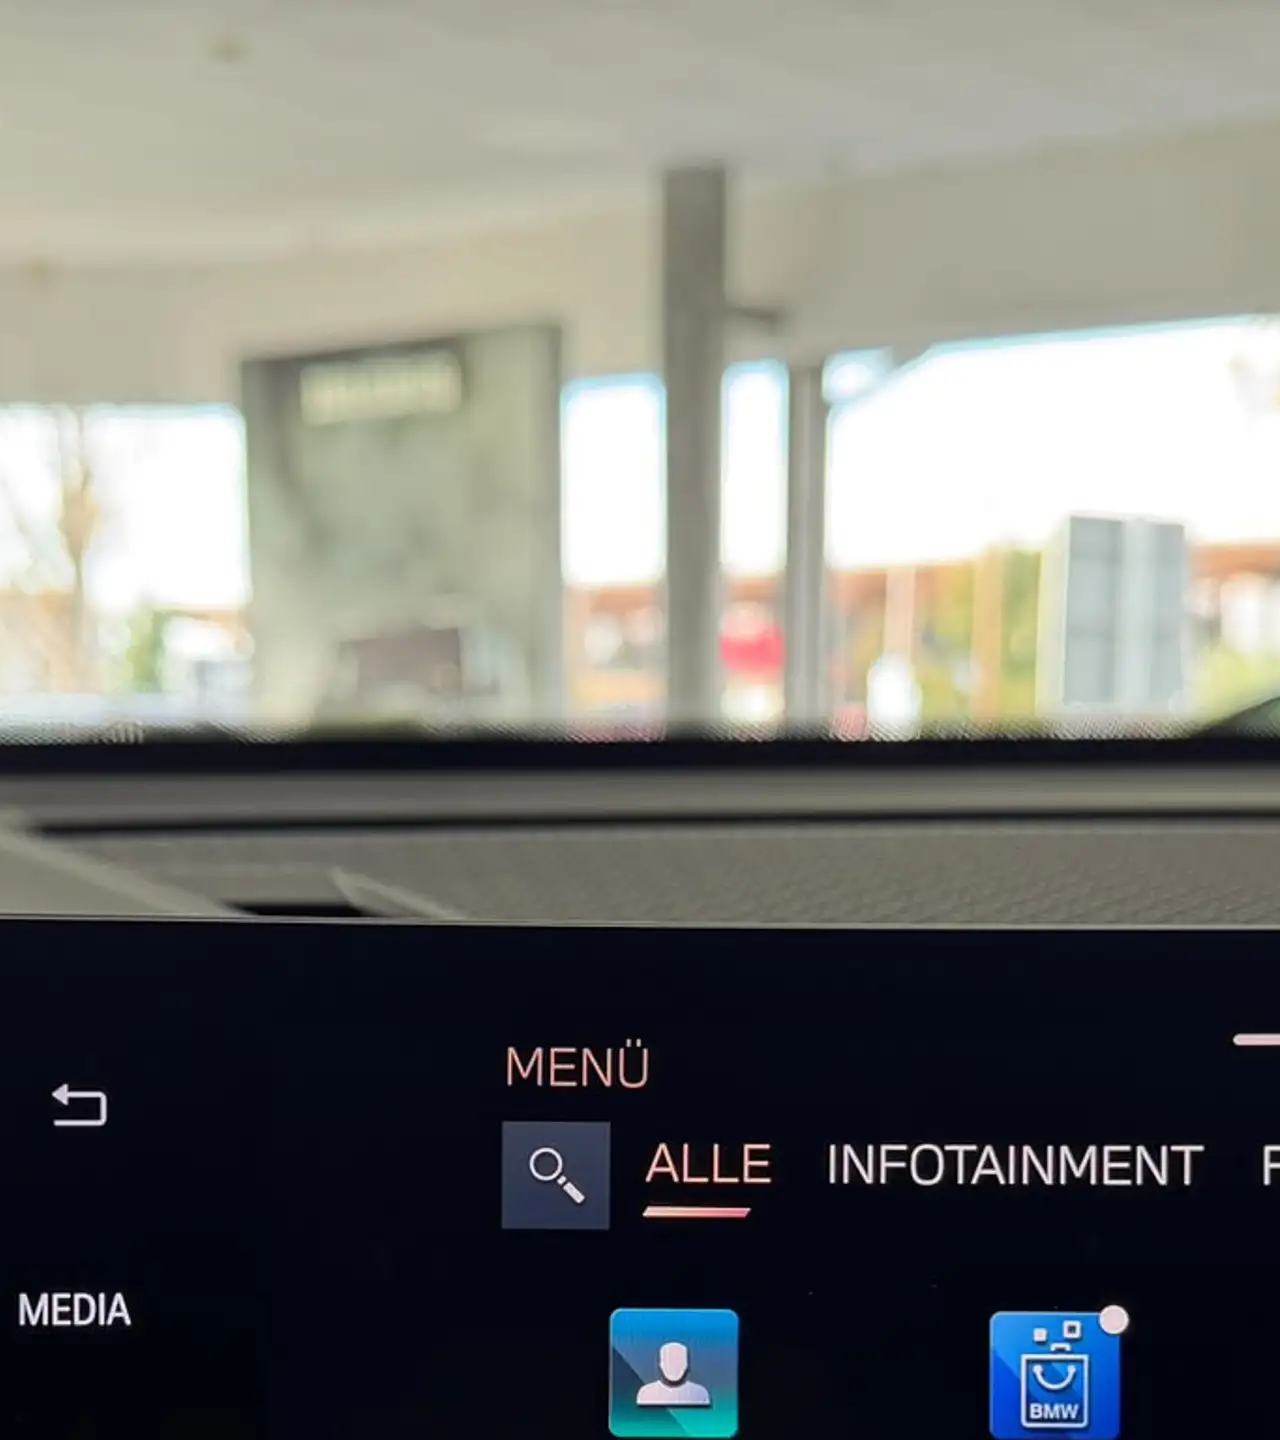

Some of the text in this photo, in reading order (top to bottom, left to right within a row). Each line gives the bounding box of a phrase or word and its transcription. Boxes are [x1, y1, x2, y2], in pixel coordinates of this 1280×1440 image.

[507, 1038, 649, 1089] MENÜ
[645, 1142, 772, 1183] ALLE
[829, 1143, 1205, 1186] INFOTAINMENT
[19, 1292, 132, 1326] MEDIA
[1028, 1401, 1081, 1421] BMW
